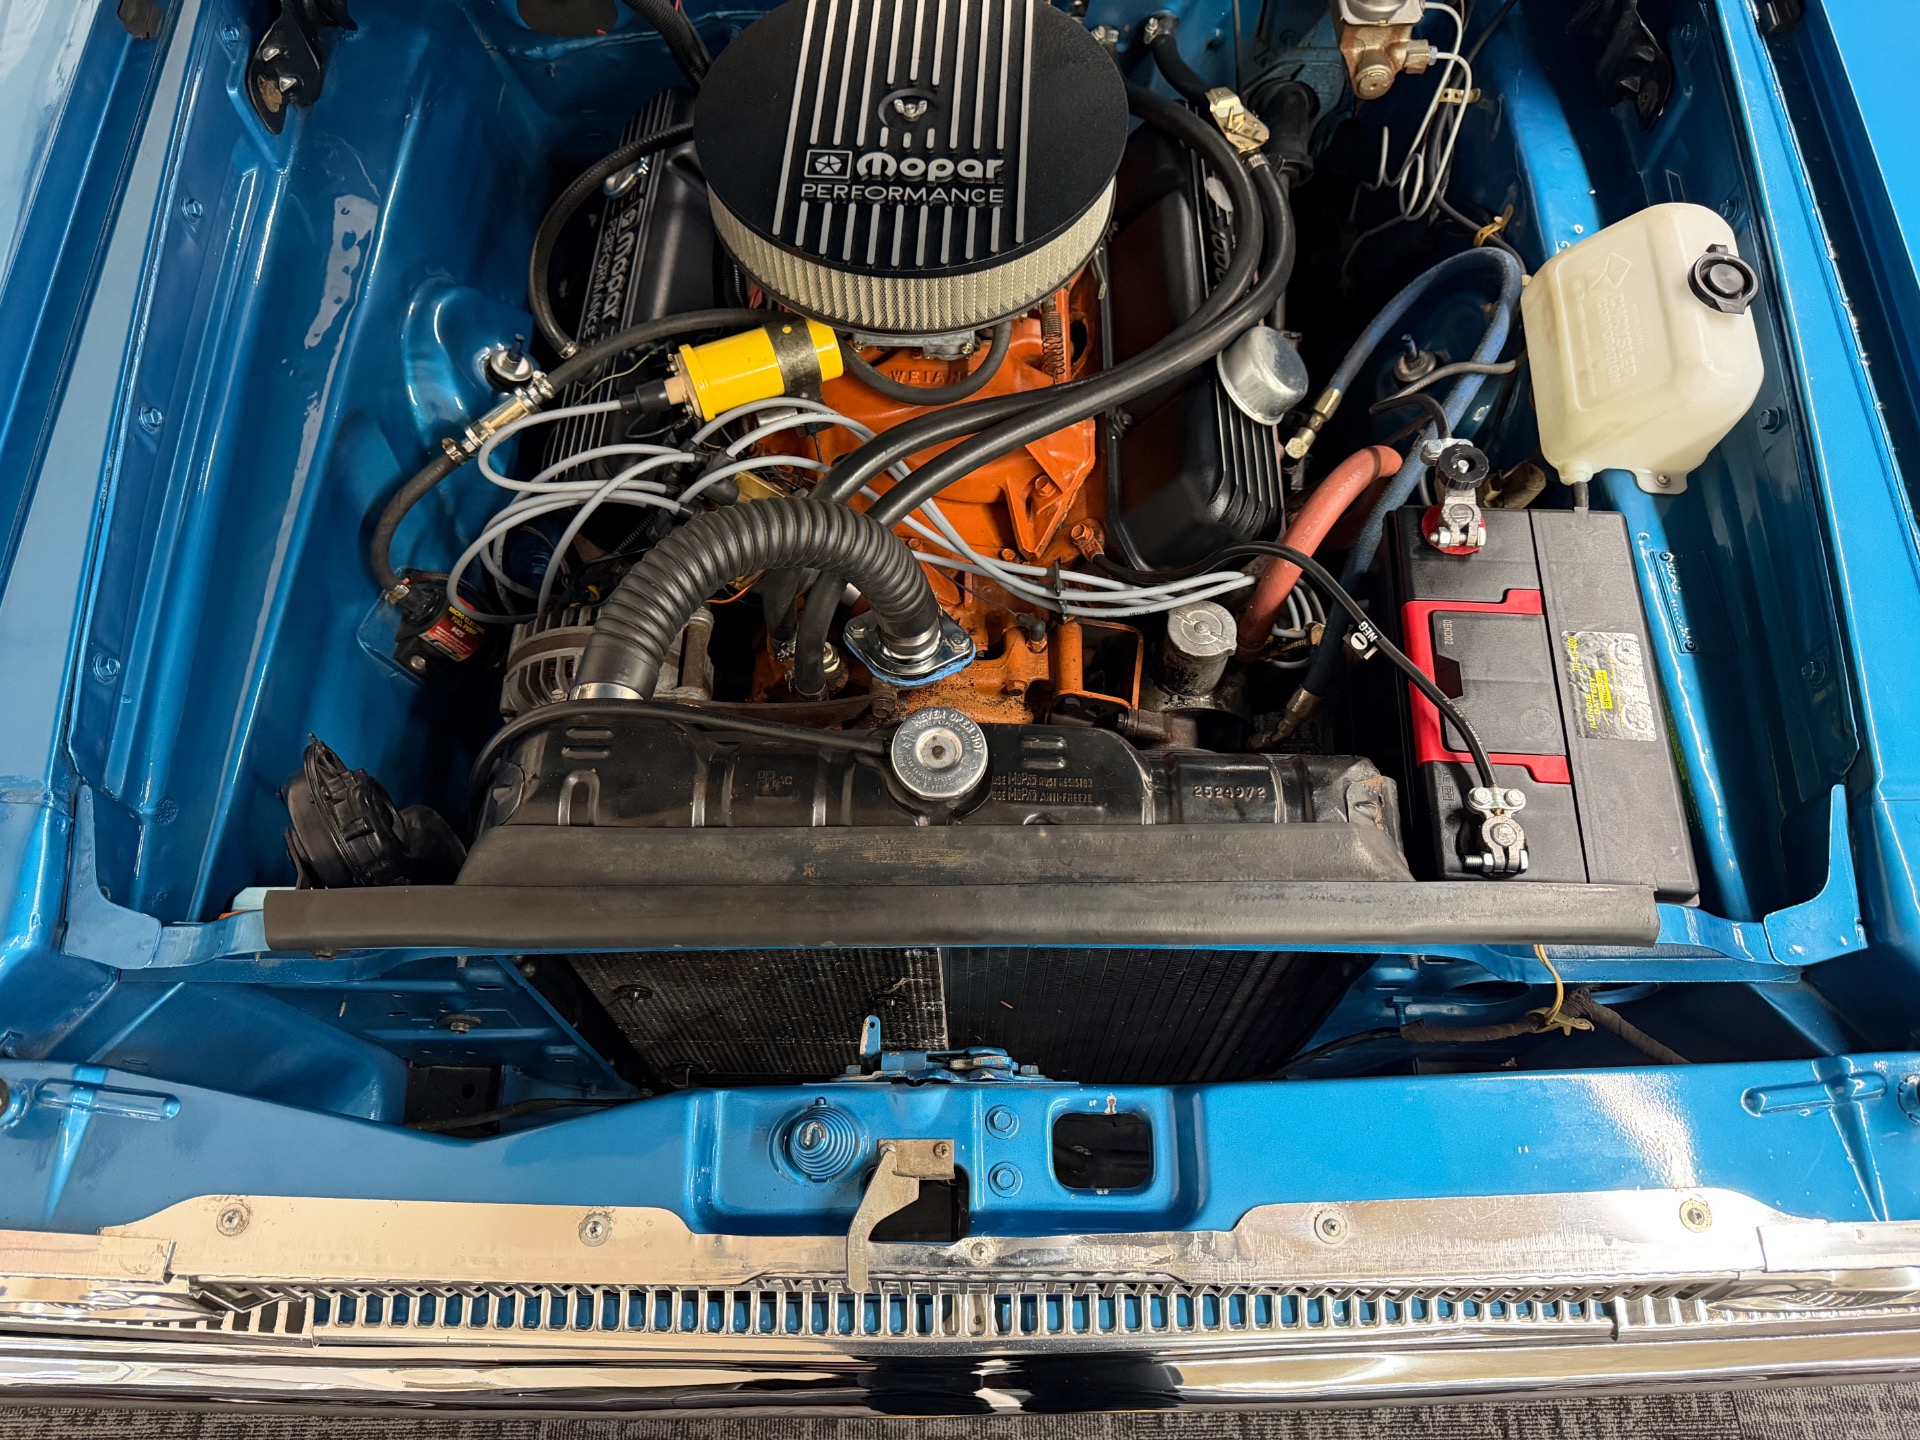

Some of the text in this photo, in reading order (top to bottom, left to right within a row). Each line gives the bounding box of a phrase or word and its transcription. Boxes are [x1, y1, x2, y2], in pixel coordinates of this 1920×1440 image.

[856, 152, 1004, 183] Mopar
[801, 184, 1004, 203] PERFORMANCE
[583, 218, 618, 339] PERFORMANCE
[602, 231, 636, 320] Mopar
[1596, 296, 1622, 385] CORPORATION
[1610, 292, 1638, 376] CHRYSLER
[451, 616, 478, 635] FUEL PUMP
[1358, 621, 1378, 642] NEG
[1585, 693, 1597, 729] ILLINOIS
[1589, 677, 1601, 715] BATTERY
[911, 709, 984, 754] NEVER OPEN HOT
[991, 775, 1006, 786] USE
[1039, 776, 1057, 787] RUST
[991, 790, 1006, 801] USE
[1040, 792, 1093, 803] ANTI-FREEZE
[1193, 785, 1266, 799] 2524972
